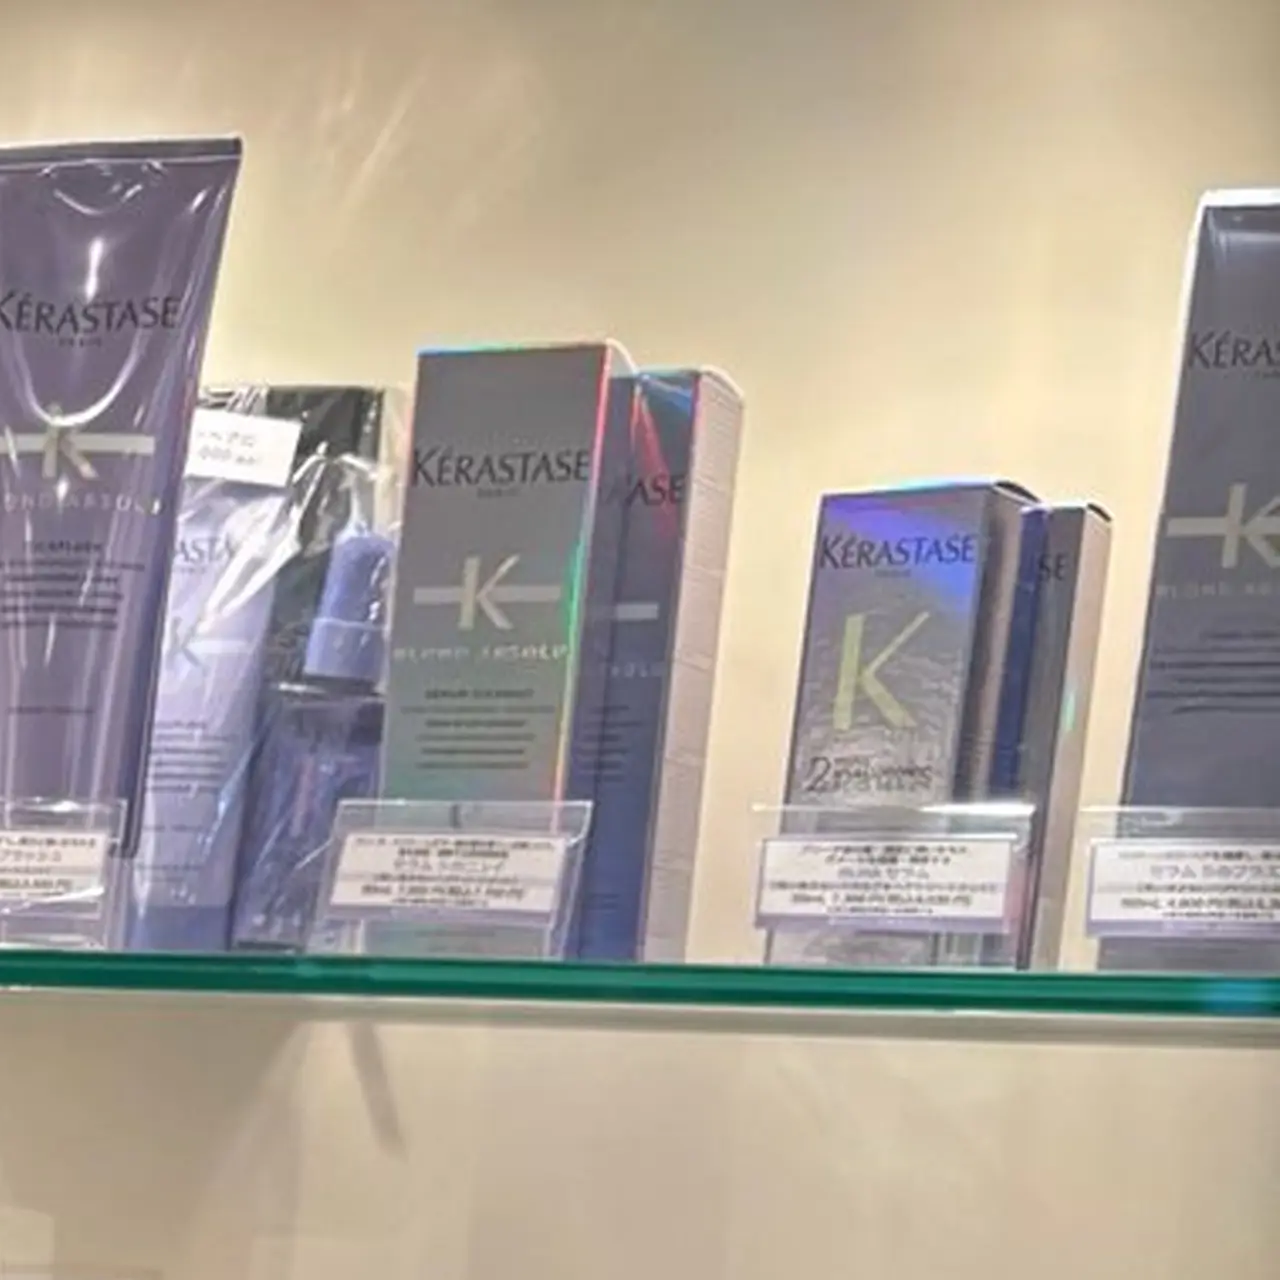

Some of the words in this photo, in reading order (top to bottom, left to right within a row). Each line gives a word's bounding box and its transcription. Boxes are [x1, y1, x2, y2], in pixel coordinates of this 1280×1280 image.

[1188, 329, 1280, 370] KÉRAS
[412, 446, 590, 489] KÉRASTASE
[819, 534, 977, 570] KÉRASTASE
[458, 554, 521, 631] K
[832, 610, 931, 731] K
